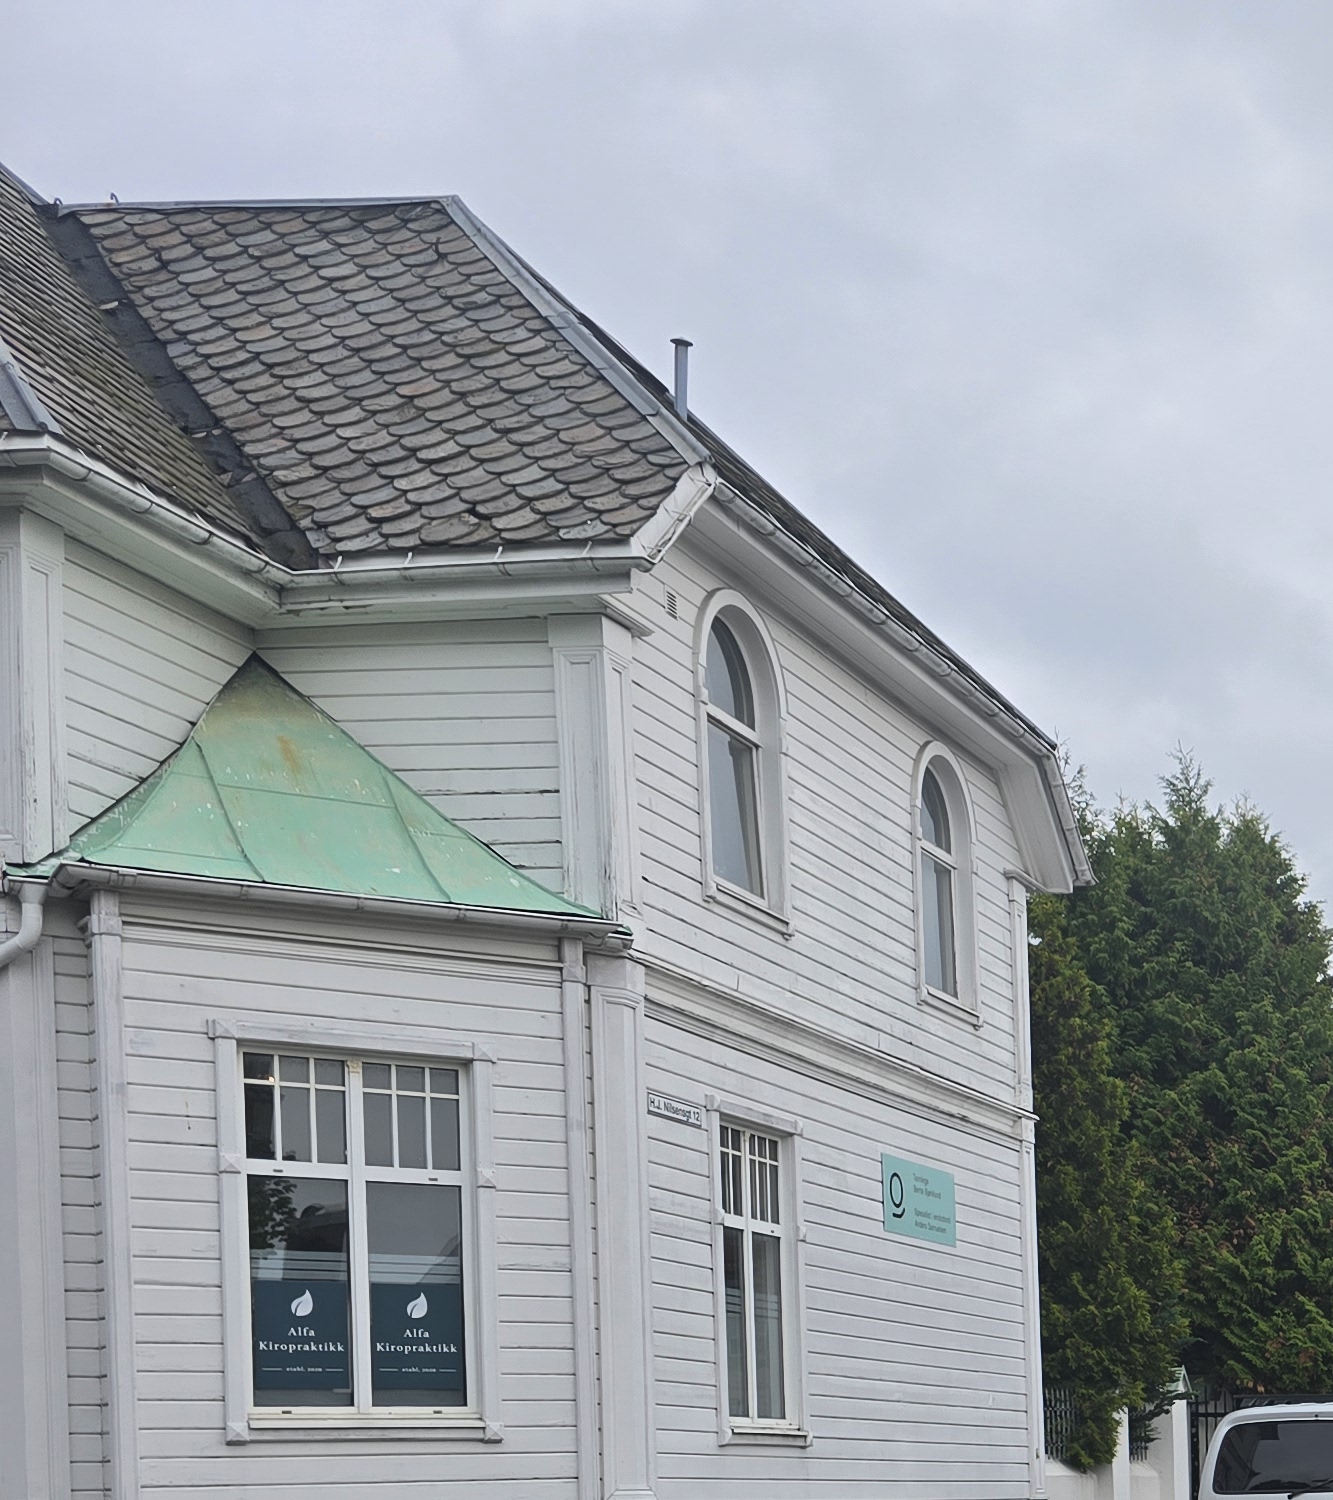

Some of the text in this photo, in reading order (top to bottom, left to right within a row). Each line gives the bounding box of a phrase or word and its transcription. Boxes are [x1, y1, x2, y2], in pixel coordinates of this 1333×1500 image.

[692, 1110, 700, 1122] 12
[287, 1326, 316, 1337] Alfa
[403, 1328, 430, 1338] Alfa
[258, 1340, 345, 1353] Kiropraktikk
[376, 1342, 458, 1354] Kiropraktikk
